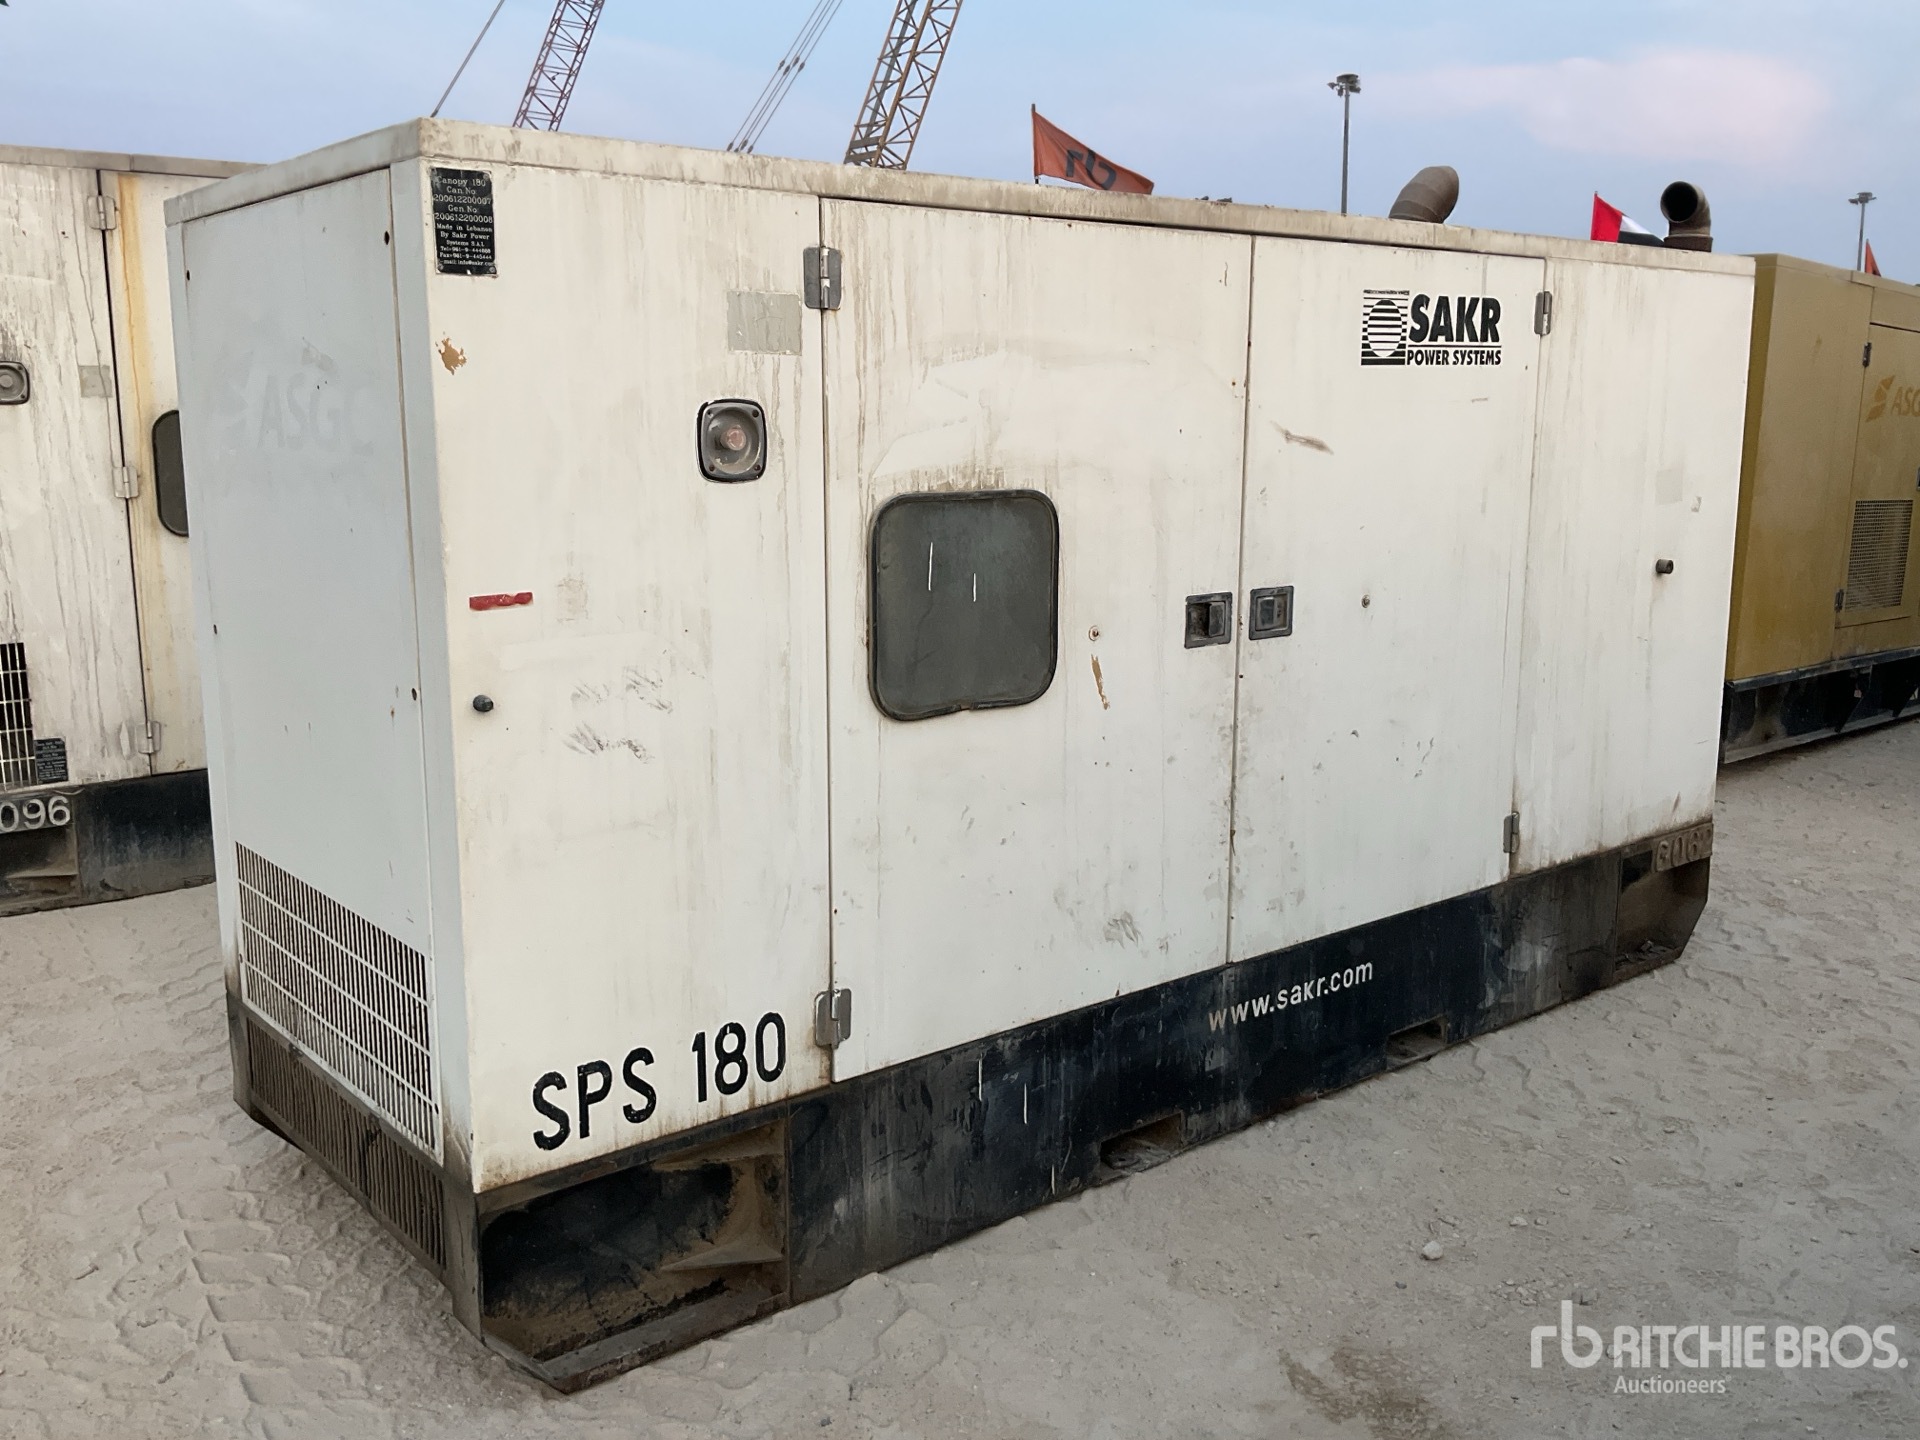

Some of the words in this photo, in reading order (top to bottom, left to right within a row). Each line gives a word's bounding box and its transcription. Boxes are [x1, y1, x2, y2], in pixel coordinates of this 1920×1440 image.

[438, 176, 467, 187] Canopy
[472, 179, 486, 187] 180
[440, 231, 449, 239] By
[451, 231, 467, 239] Sakr
[470, 232, 490, 240] Power
[1408, 294, 1502, 343] SAKR
[1406, 350, 1450, 366] POWER
[1452, 350, 1502, 366] SYSTEMS
[0, 796, 71, 832] 096
[1208, 961, 1373, 1032] www.sakr.com
[532, 1071, 656, 1151] SPS
[692, 1011, 787, 1103] 180
